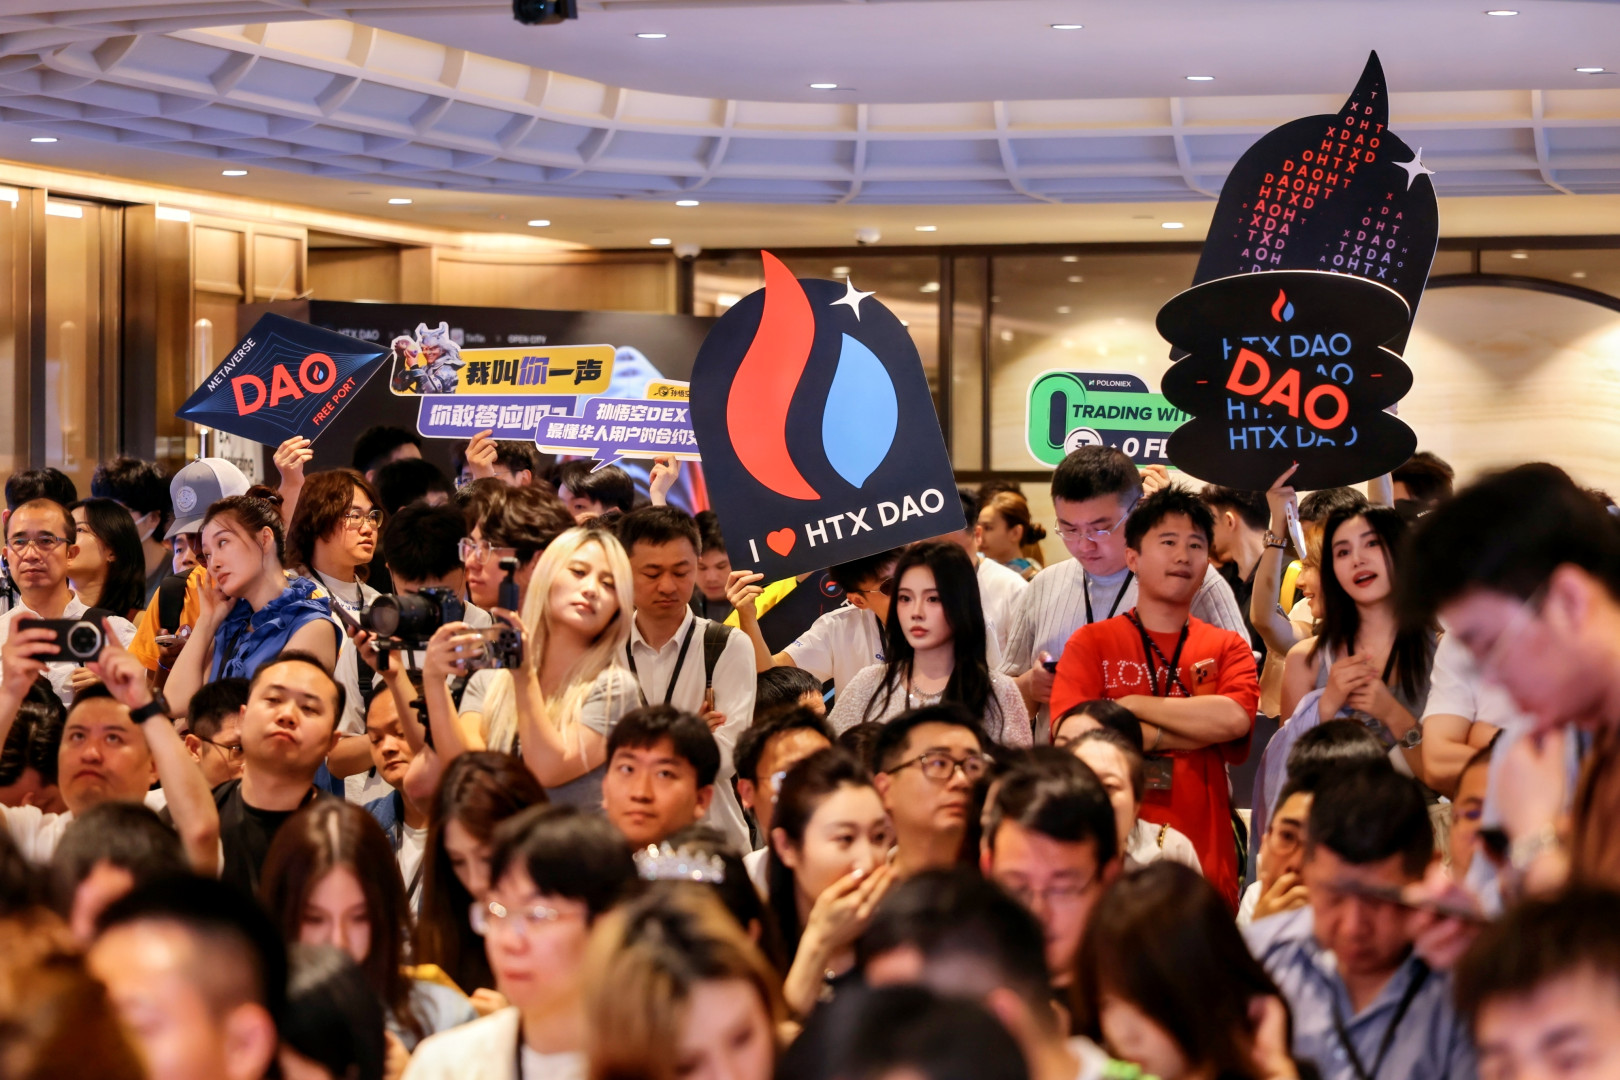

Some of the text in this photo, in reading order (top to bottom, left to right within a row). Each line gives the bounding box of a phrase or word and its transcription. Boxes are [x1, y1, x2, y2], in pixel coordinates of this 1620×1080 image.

[1289, 332, 1352, 358] DAO
[208, 338, 256, 391] METAVERSE
[465, 356, 603, 386] 我叫你一声
[230, 352, 337, 417] DAO
[1096, 379, 1132, 388] POLONIEX
[1225, 347, 1350, 431] DAO
[311, 376, 356, 426] FREE PORT
[596, 403, 688, 423] 孙悟空DEX
[1072, 404, 1195, 422] TRADING WIT
[1122, 437, 1140, 458] 0
[1229, 426, 1289, 450] HTX
[749, 488, 945, 563] I HTX DAO
